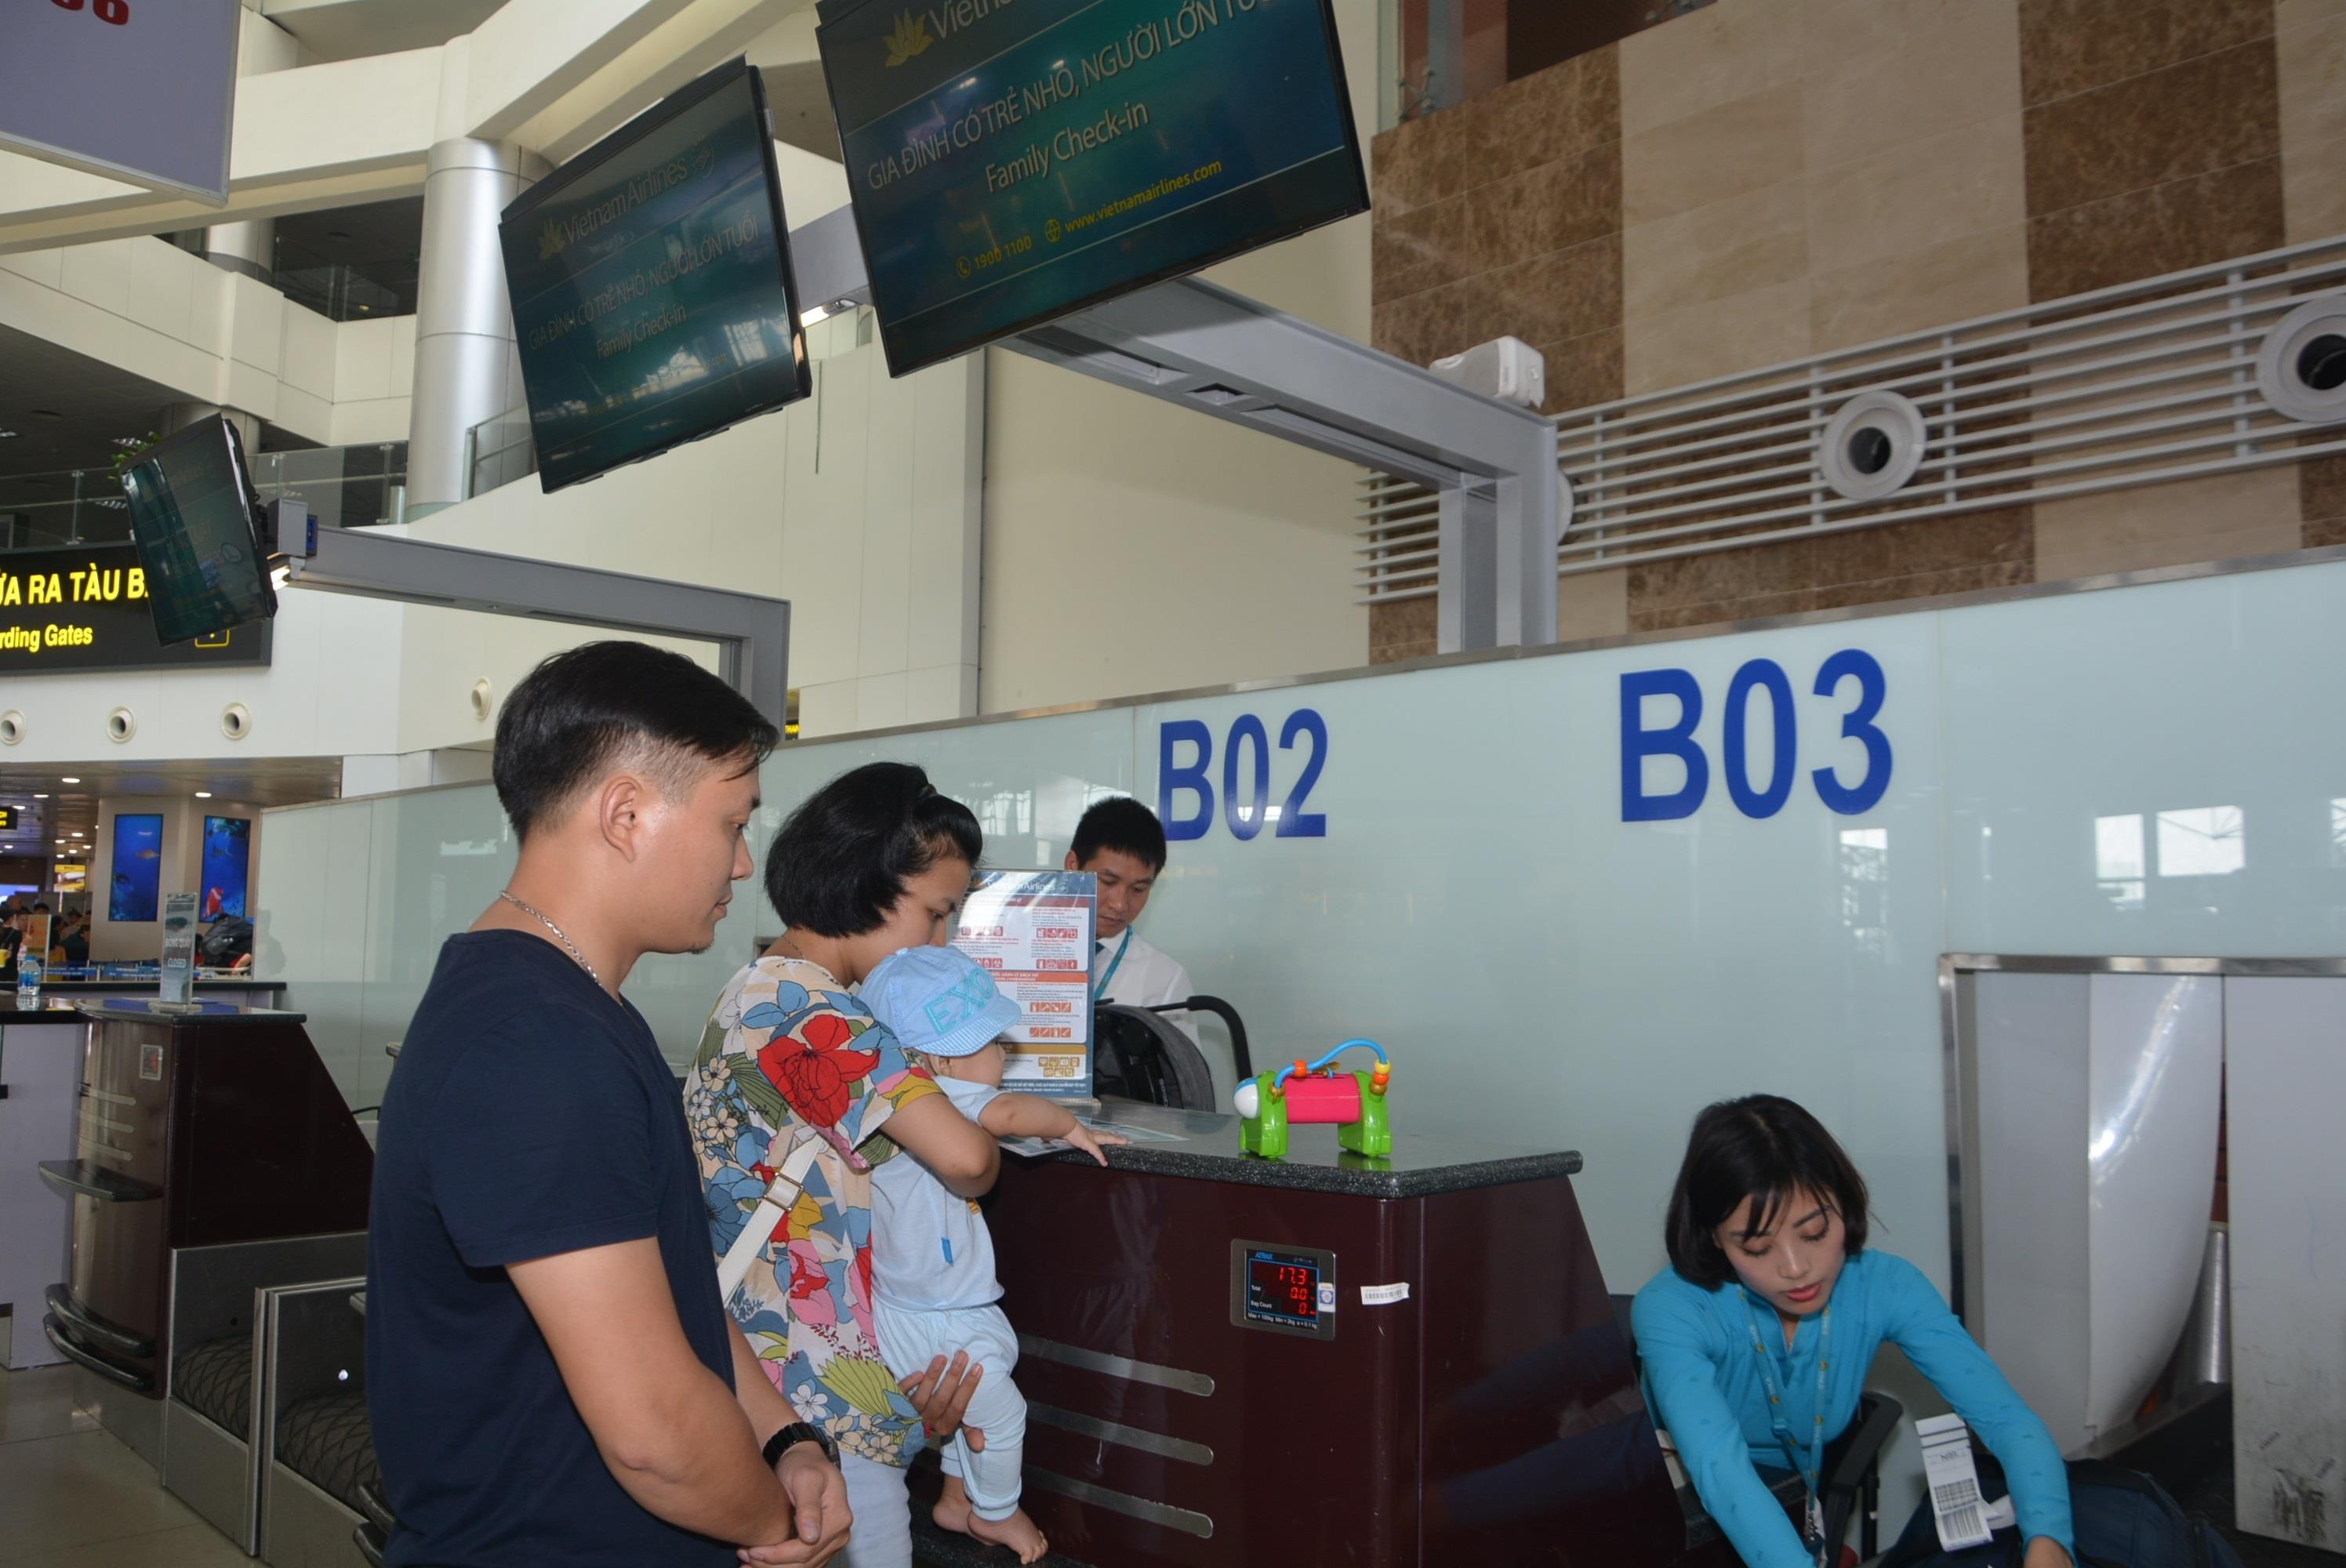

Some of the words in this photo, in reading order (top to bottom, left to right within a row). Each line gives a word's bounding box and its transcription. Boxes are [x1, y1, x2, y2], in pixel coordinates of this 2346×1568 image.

[868, 156, 901, 190] GIA
[902, 132, 950, 175] ĐÌNH
[953, 108, 981, 148] CÓ
[981, 86, 1022, 133] TRẺ
[1081, 22, 1162, 88] NGƯỜI
[1164, 0, 1218, 47] LỚN
[986, 144, 1049, 193] Family
[1055, 100, 1149, 161] Check-in
[564, 194, 626, 245] Vietnam
[626, 157, 688, 212] Airlines
[1066, 160, 1223, 233] www.vietnamairlines.com
[974, 246, 1003, 270] 1900
[1004, 235, 1033, 258] 1100
[596, 325, 633, 361] Family
[634, 303, 687, 342] Check-in
[28, 573, 62, 604] RA
[70, 562, 121, 602] TÀU
[45, 624, 93, 647] Gates
[1619, 648, 1893, 824] B03
[1160, 707, 1328, 843] B02
[167, 957, 187, 968] CLOSED
[924, 967, 994, 1036] EXO
